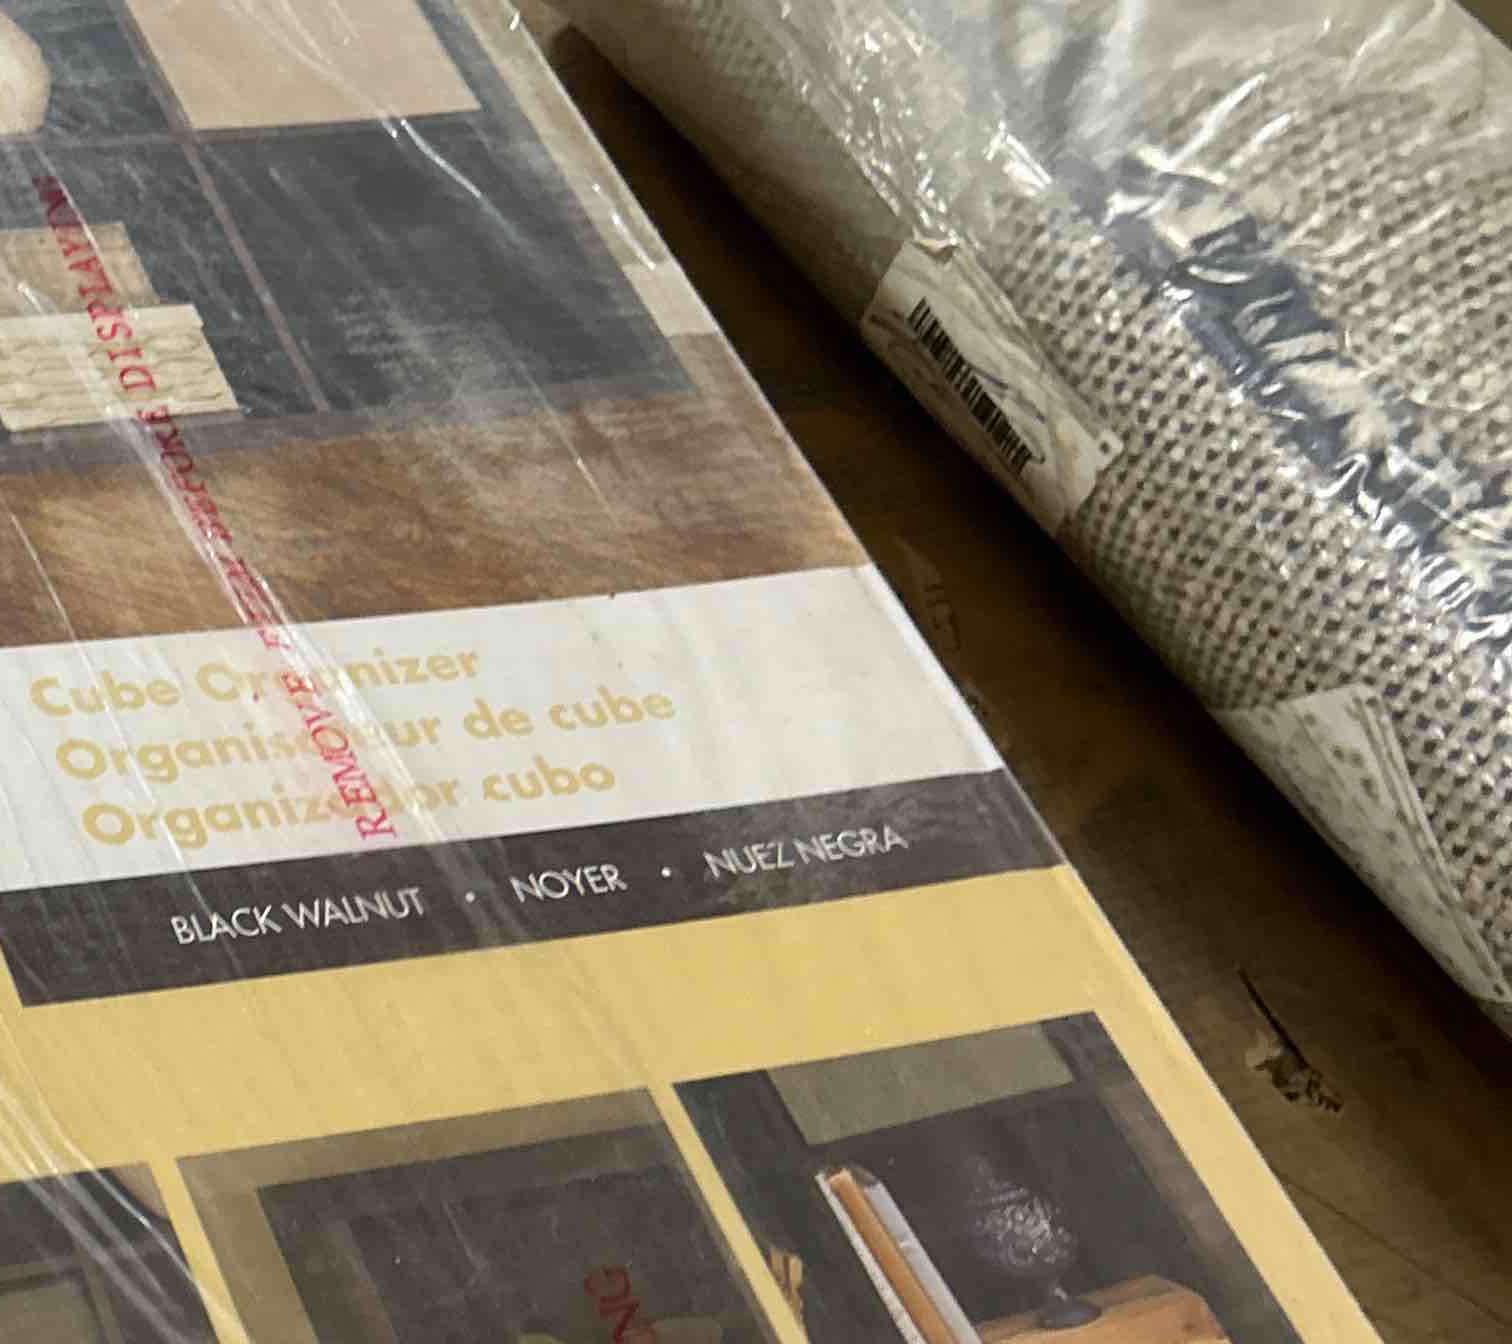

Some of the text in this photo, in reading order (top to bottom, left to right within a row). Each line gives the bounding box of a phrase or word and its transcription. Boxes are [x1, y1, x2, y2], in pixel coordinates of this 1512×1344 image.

[30, 646, 480, 716] Cube Ornizer
[56, 687, 676, 783] Organisur de cube
[280, 670, 398, 840] REMOVE
[481, 761, 616, 804] cubo
[171, 825, 909, 945] BLACK WALNUT NOYER NUEZ NEGRA
